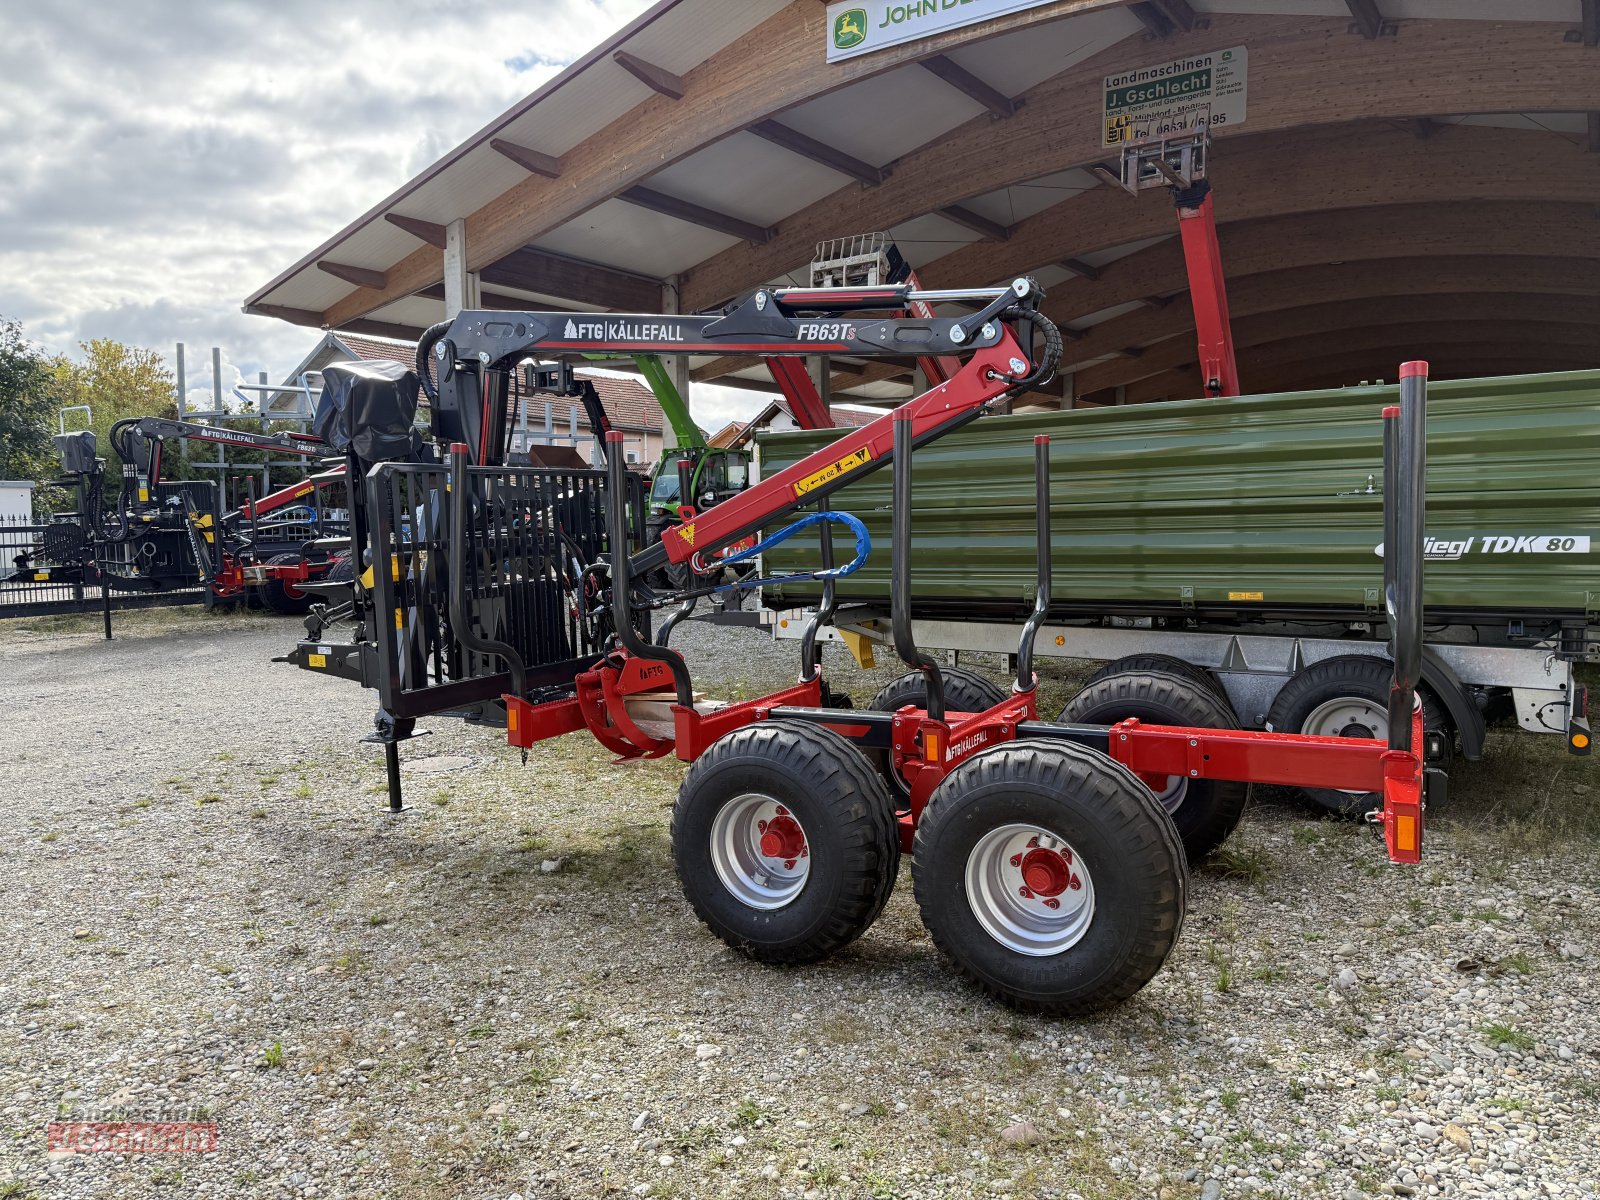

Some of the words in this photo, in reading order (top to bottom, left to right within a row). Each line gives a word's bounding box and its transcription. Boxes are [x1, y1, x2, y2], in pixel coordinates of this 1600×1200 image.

[879, 0, 938, 28] JOHN
[1106, 57, 1212, 88] Landmaschinen
[1109, 93, 1122, 107] J.
[1126, 74, 1208, 103] Gschlecht
[1148, 101, 1163, 109] und
[578, 324, 603, 340] FTG
[609, 320, 684, 341] KÄLLEFALL
[1423, 536, 1475, 558] liegl
[1481, 536, 1539, 554] TDK
[1546, 537, 1576, 551] 80
[648, 665, 664, 678] FTG
